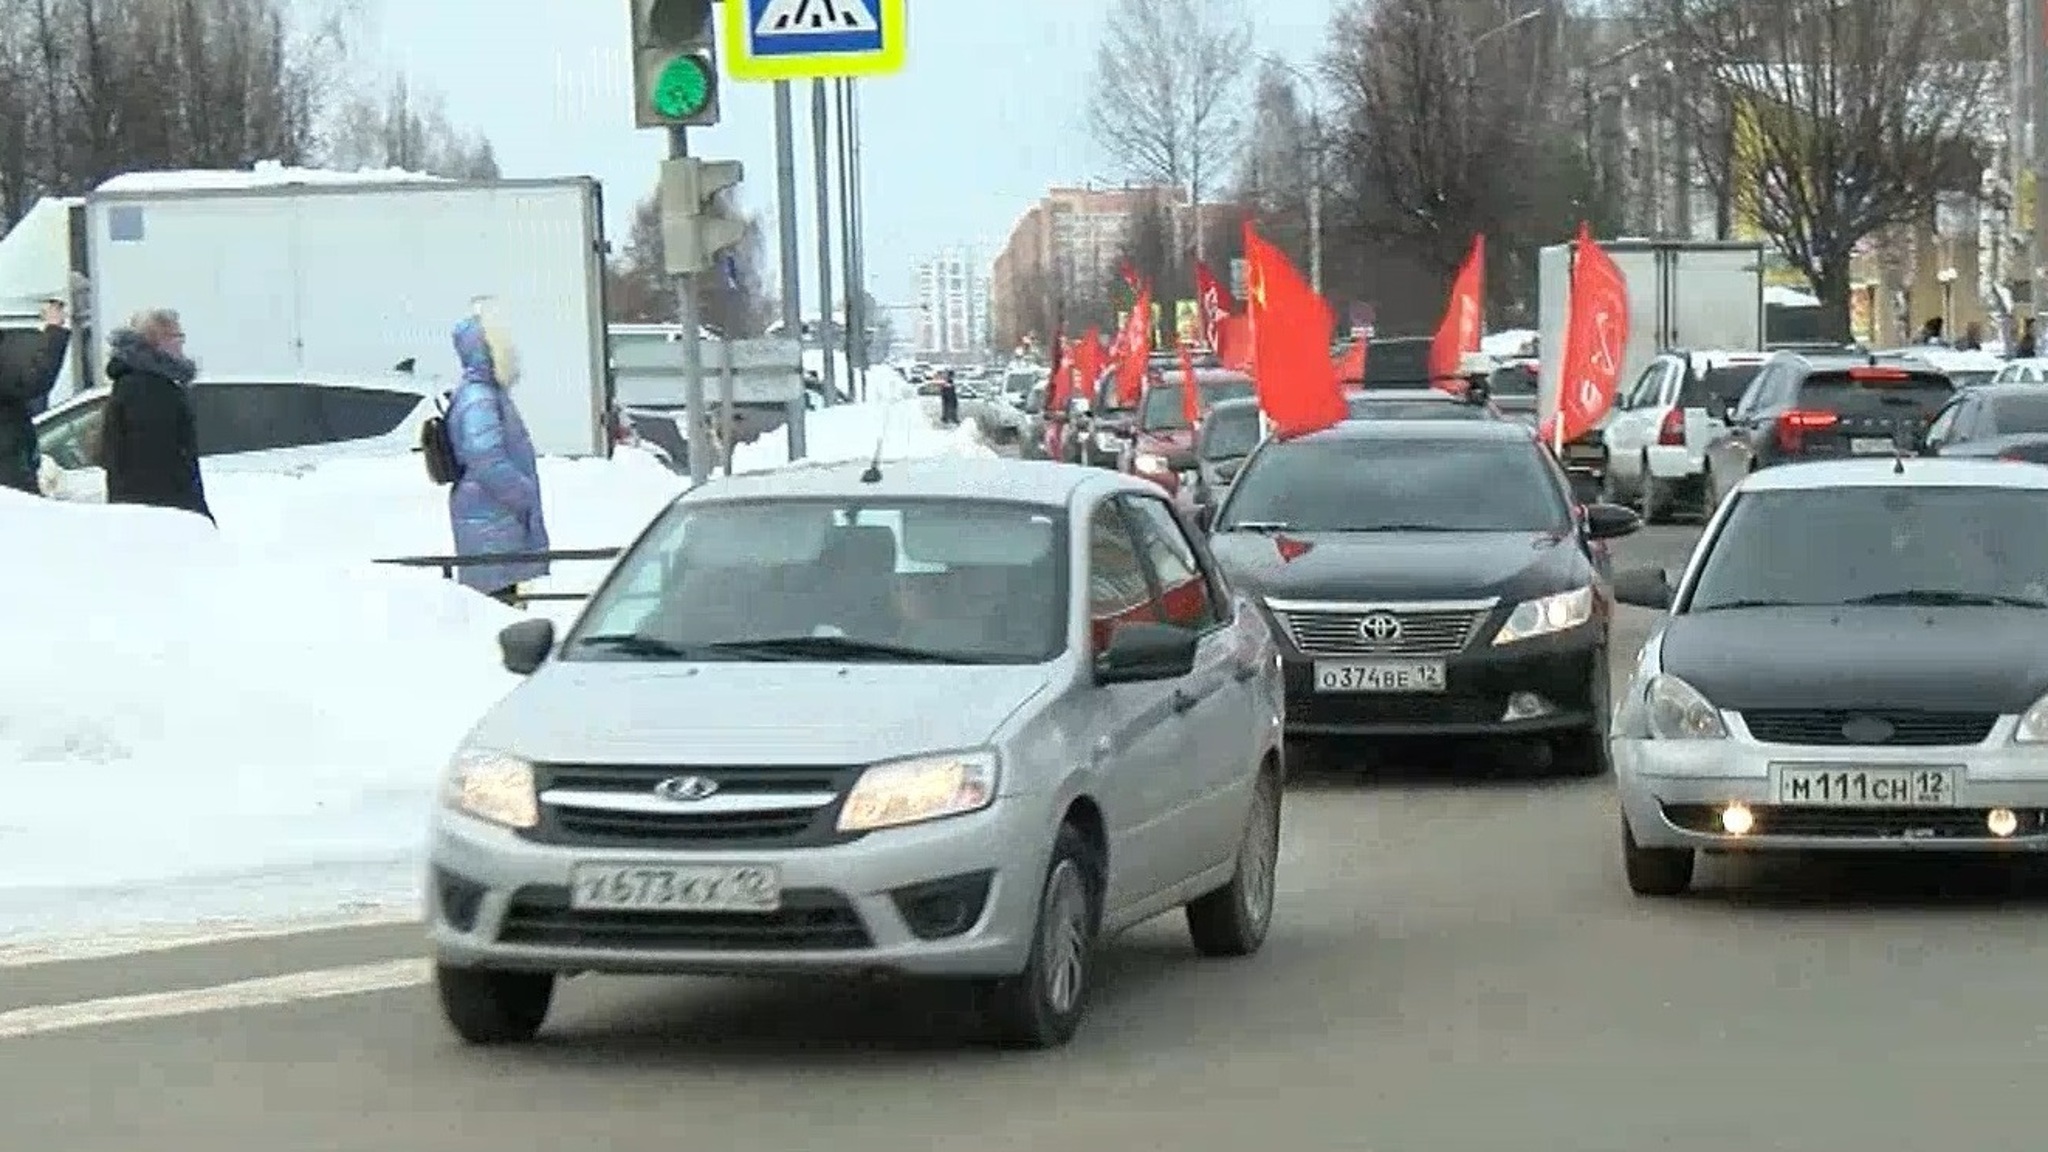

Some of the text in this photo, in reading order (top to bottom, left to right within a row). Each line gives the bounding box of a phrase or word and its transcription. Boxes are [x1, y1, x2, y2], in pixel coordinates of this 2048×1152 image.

[1323, 665, 1437, 688] О374ВЕ 12
[1792, 771, 1943, 800] М111СН 12
